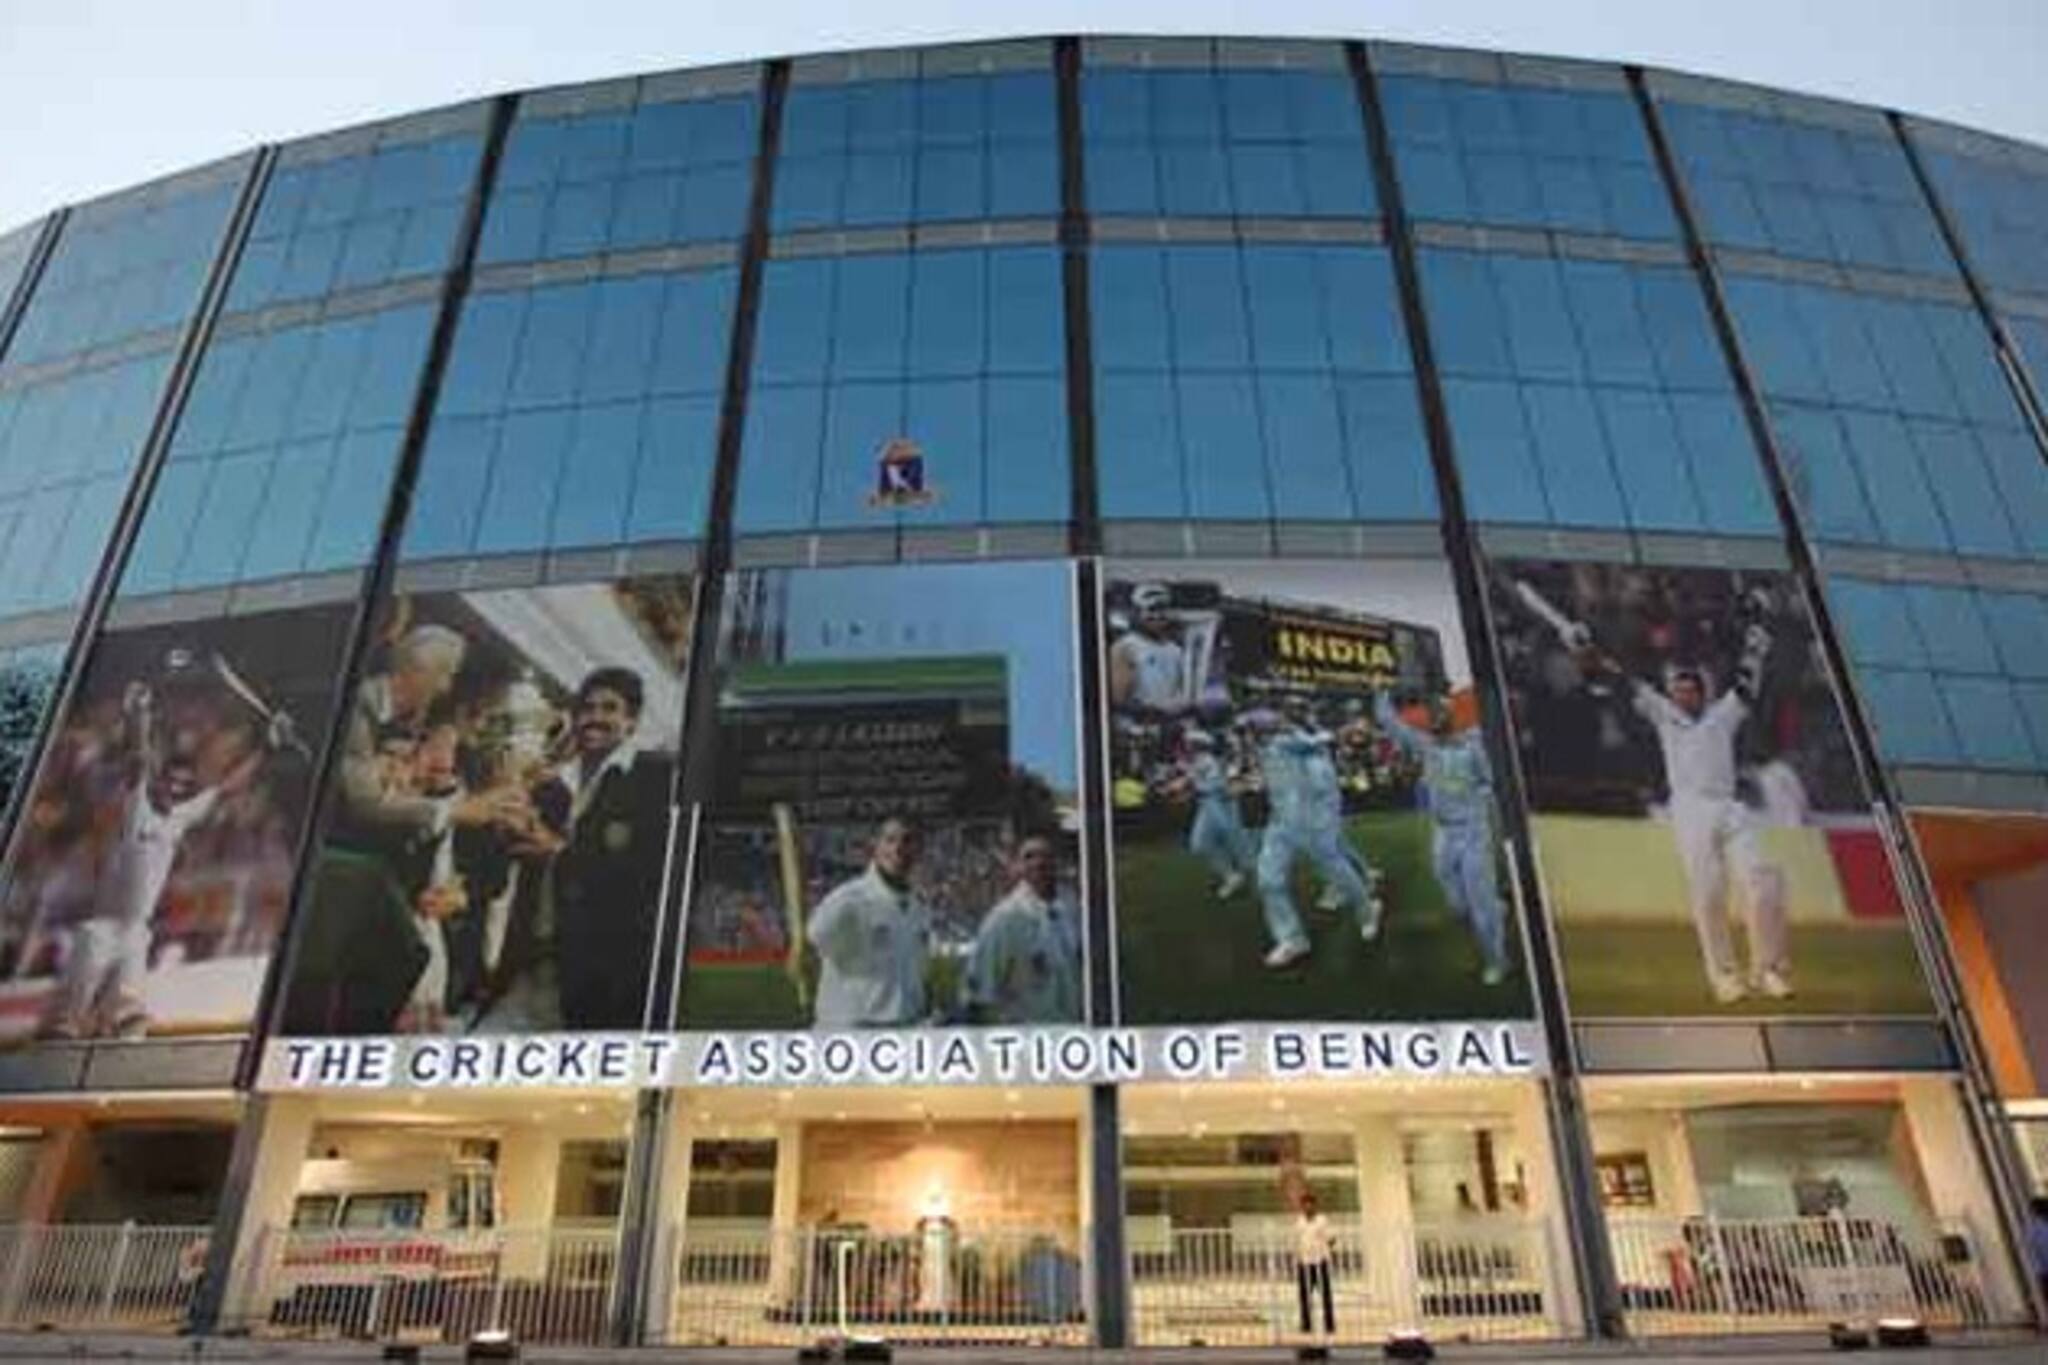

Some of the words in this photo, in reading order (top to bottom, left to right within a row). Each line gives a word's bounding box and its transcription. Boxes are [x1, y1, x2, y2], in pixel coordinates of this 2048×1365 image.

[1277, 629, 1394, 668] INDIA
[288, 1043, 385, 1080] THE
[410, 1040, 669, 1079] CRICKET
[699, 1036, 1139, 1076] ASSOCIATION
[1169, 1033, 1241, 1071] OF
[1274, 1030, 1533, 1070] BENGAL
